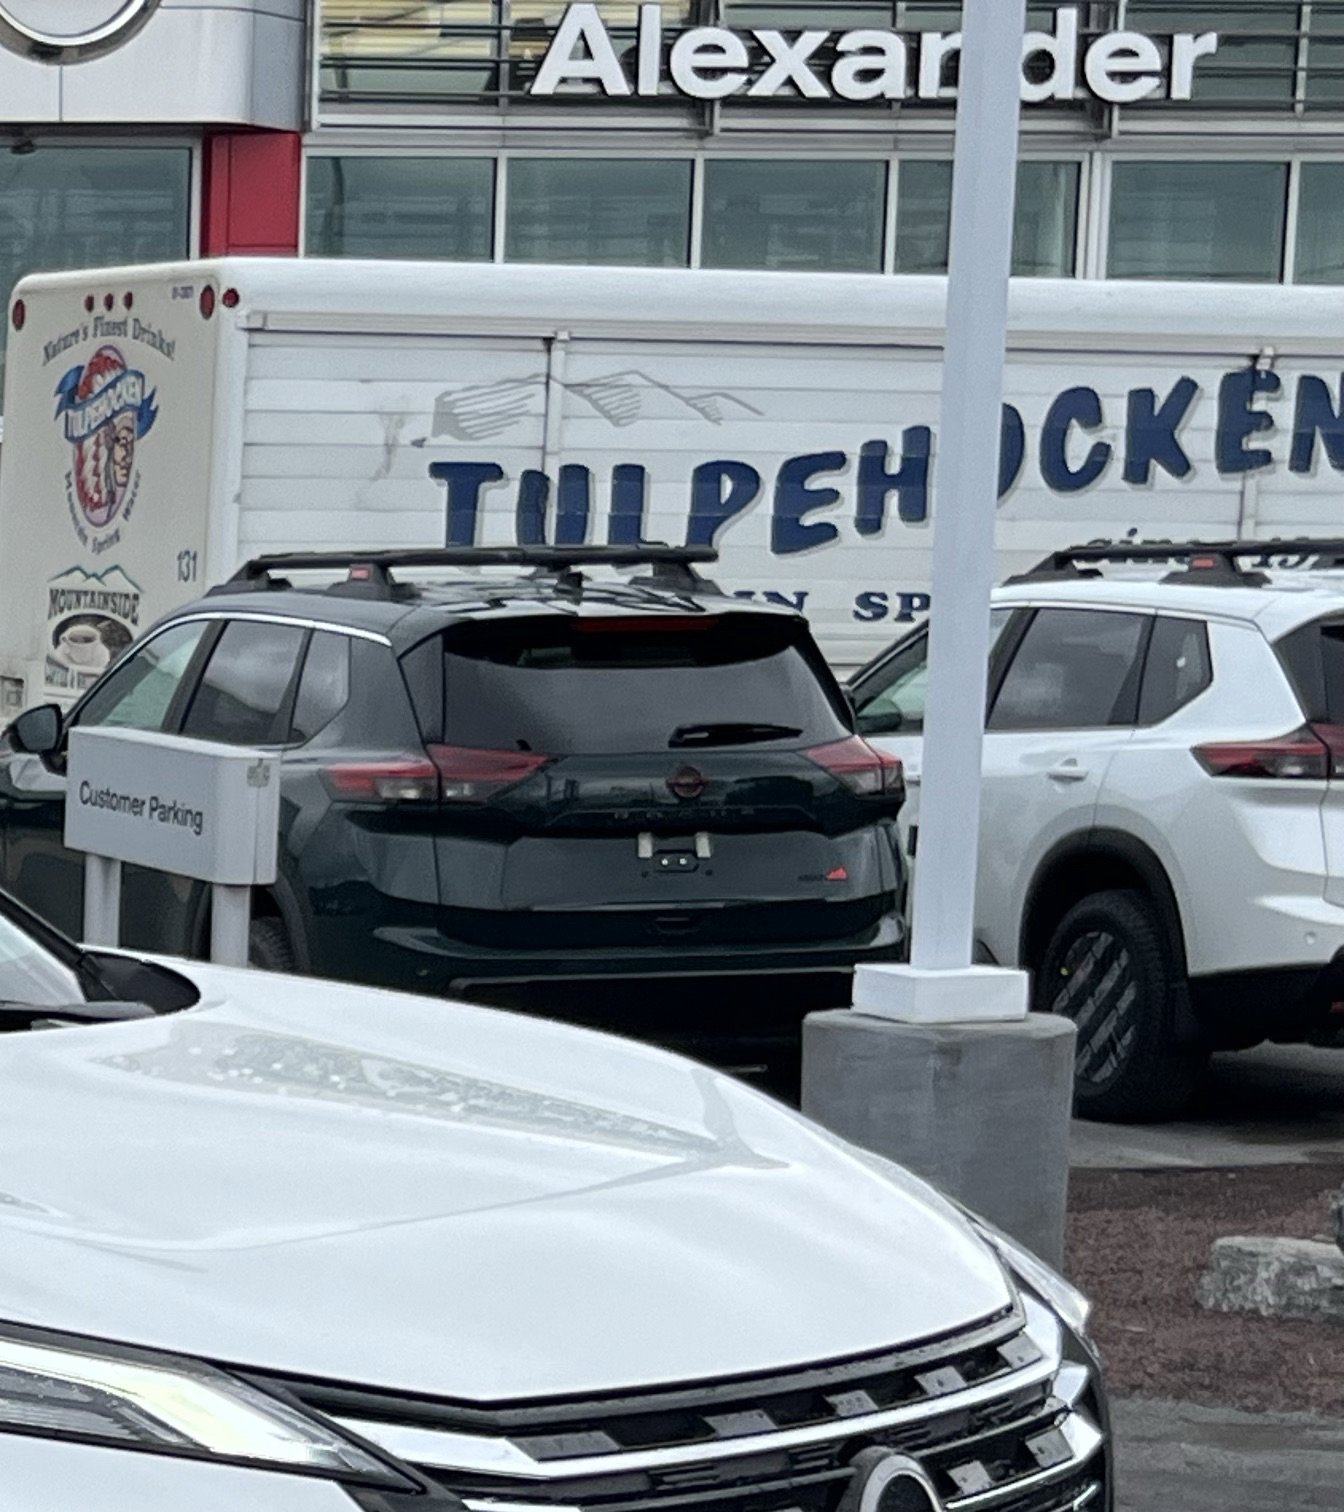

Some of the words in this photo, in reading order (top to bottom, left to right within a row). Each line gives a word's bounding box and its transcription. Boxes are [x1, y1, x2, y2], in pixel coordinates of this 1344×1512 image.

[42, 322, 89, 366] Nature's
[93, 315, 128, 338] Finest
[133, 317, 176, 361] Drinks!
[177, 550, 198, 582] 131
[48, 588, 140, 626] MOUNTAINSIDE
[79, 780, 146, 817] Customer
[149, 796, 204, 836] Parking
